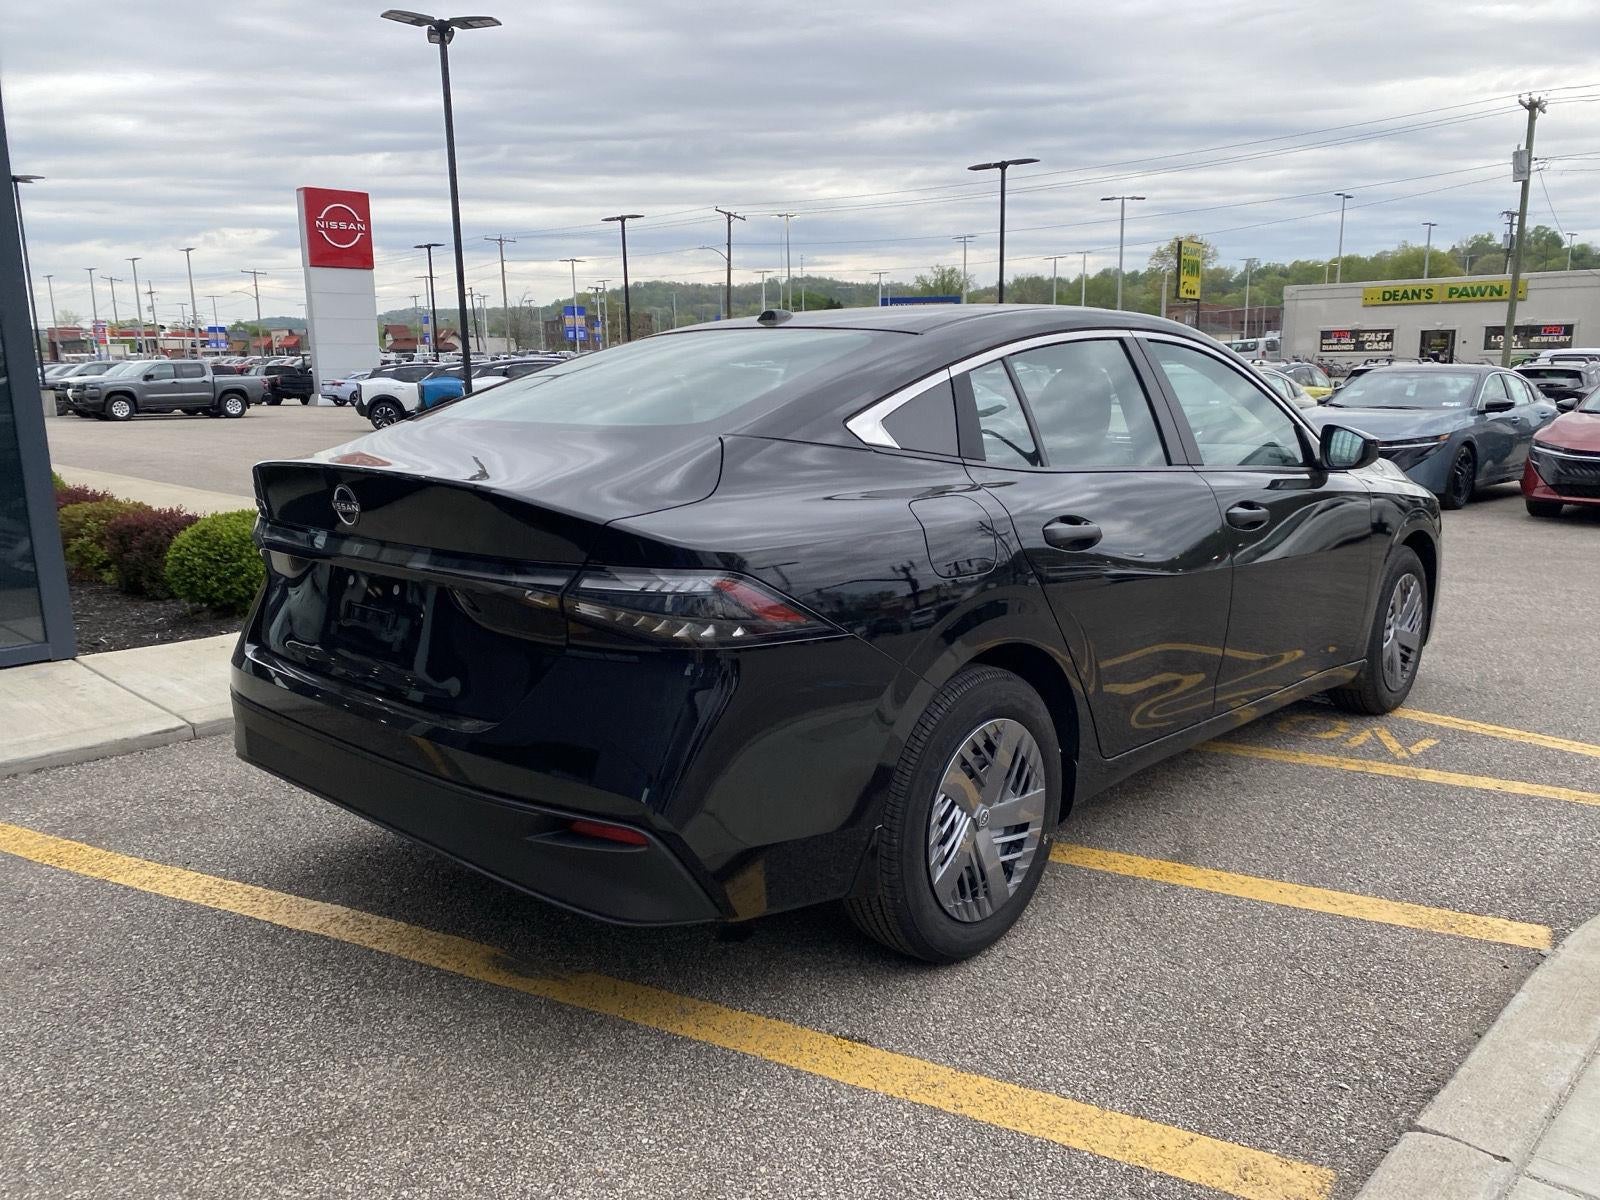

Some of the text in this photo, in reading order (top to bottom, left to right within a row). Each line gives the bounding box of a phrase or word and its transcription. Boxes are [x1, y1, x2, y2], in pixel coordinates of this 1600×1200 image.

[315, 220, 366, 231] NISSAN
[1448, 285, 1504, 298] PAWN
[1363, 333, 1390, 341] FAST
[1530, 335, 1571, 343] JEWELRY
[1365, 342, 1393, 350] CASH
[1499, 341, 1524, 349] SLL
